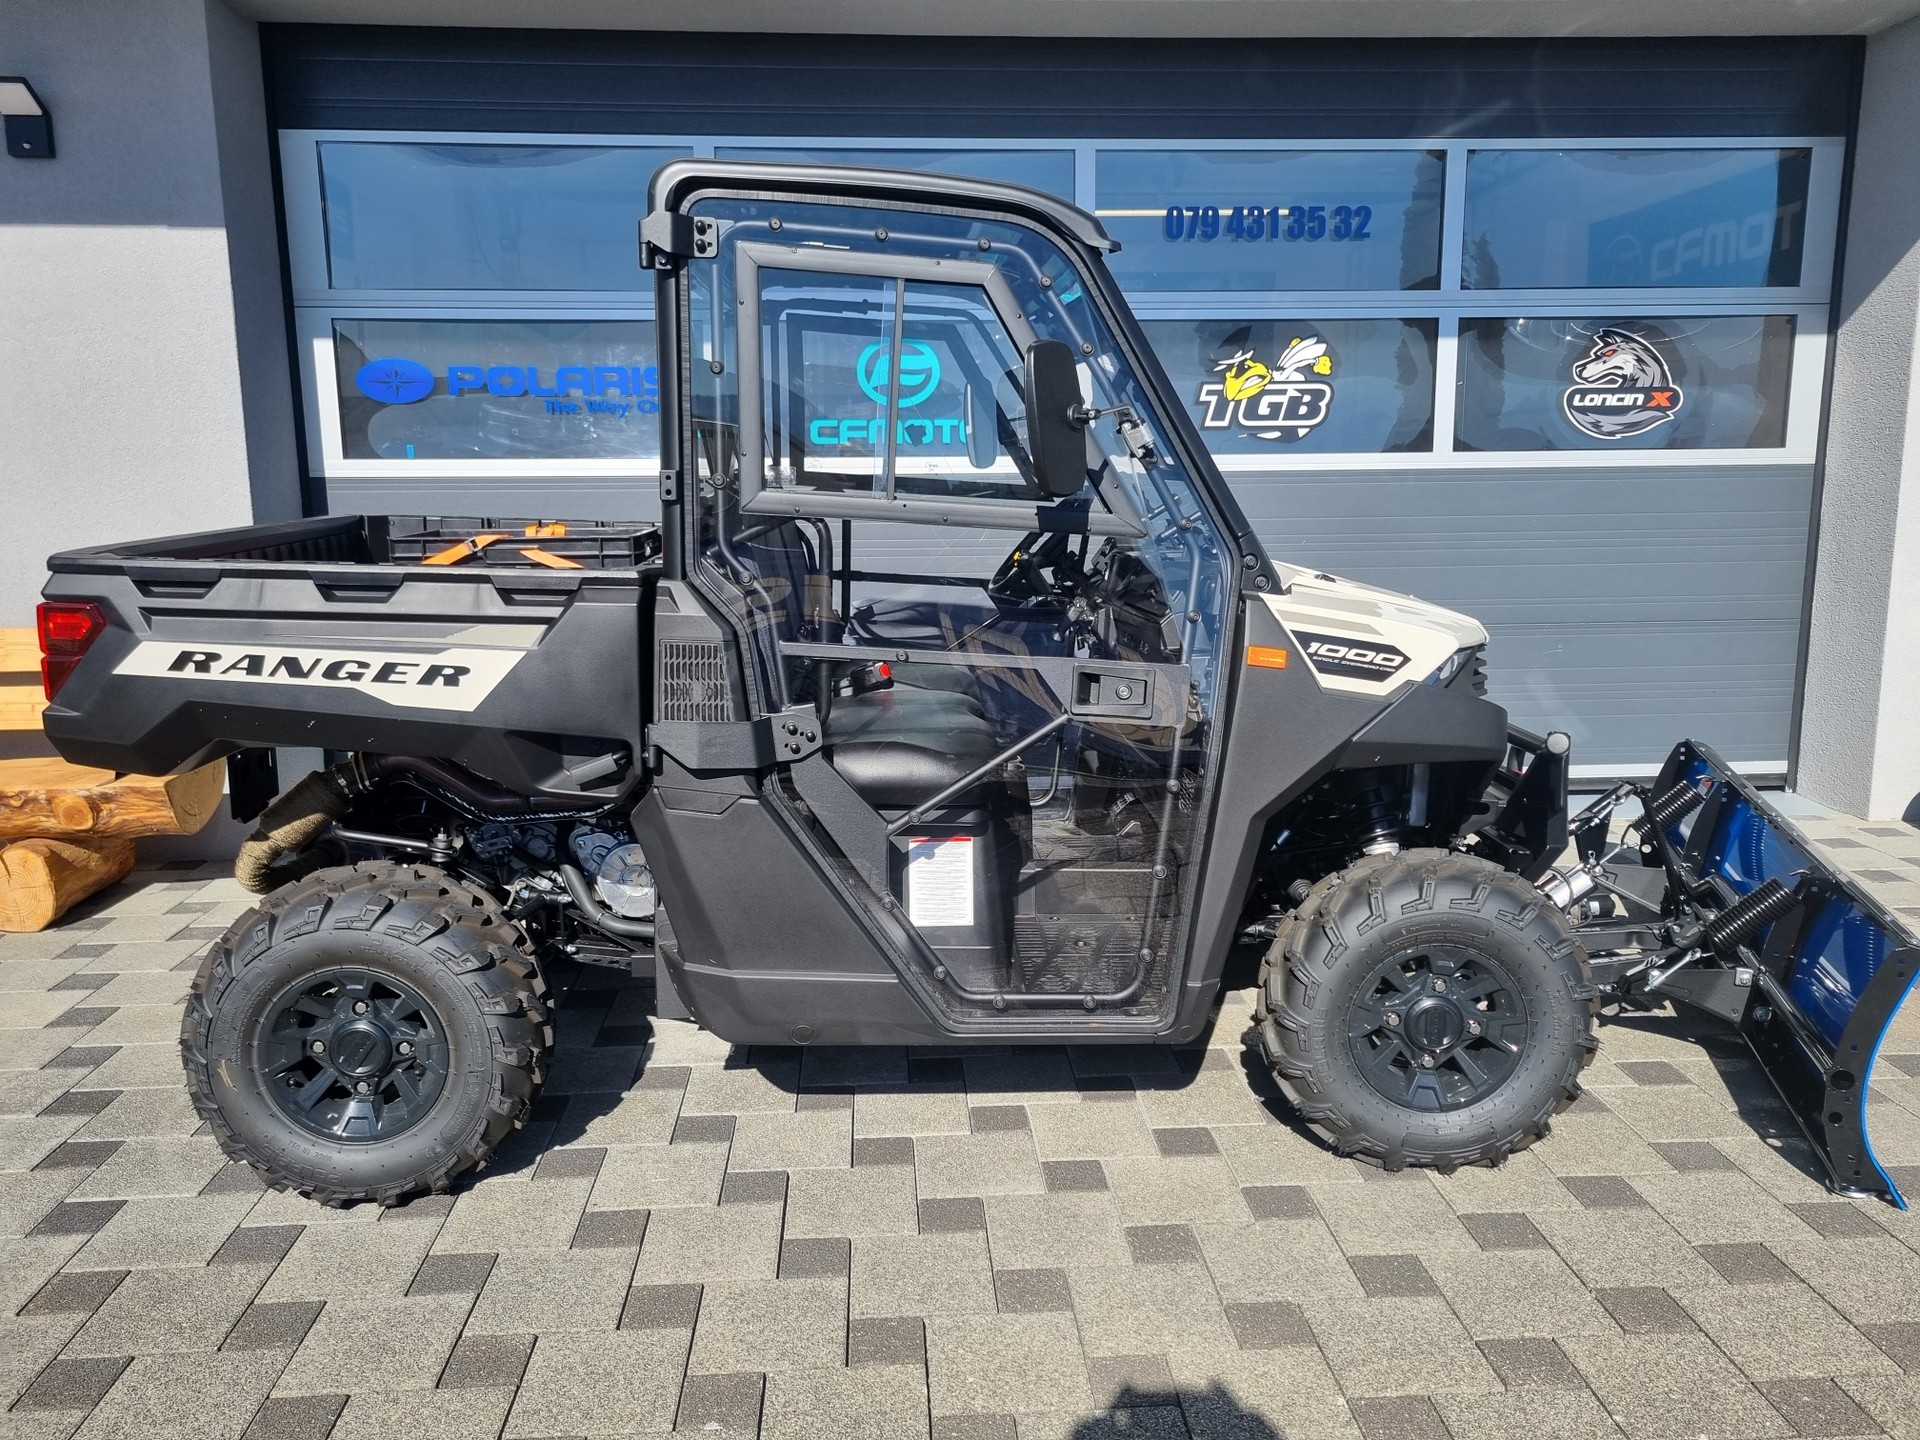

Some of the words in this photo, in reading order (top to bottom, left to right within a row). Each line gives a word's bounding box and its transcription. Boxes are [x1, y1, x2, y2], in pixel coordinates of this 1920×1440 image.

[1165, 205, 1220, 240] 079
[1227, 205, 1280, 240] 431
[1287, 205, 1327, 240] 35
[1333, 205, 1373, 240] 32
[544, 400, 578, 414] The
[584, 400, 631, 418] Way
[637, 399, 659, 415] O
[1199, 383, 1332, 428] TGB
[1645, 391, 1674, 407] X
[809, 419, 968, 445] CFMOT
[1306, 642, 1404, 667] 1000
[1312, 655, 1340, 664] SINGLE
[166, 649, 472, 688] RANGER
